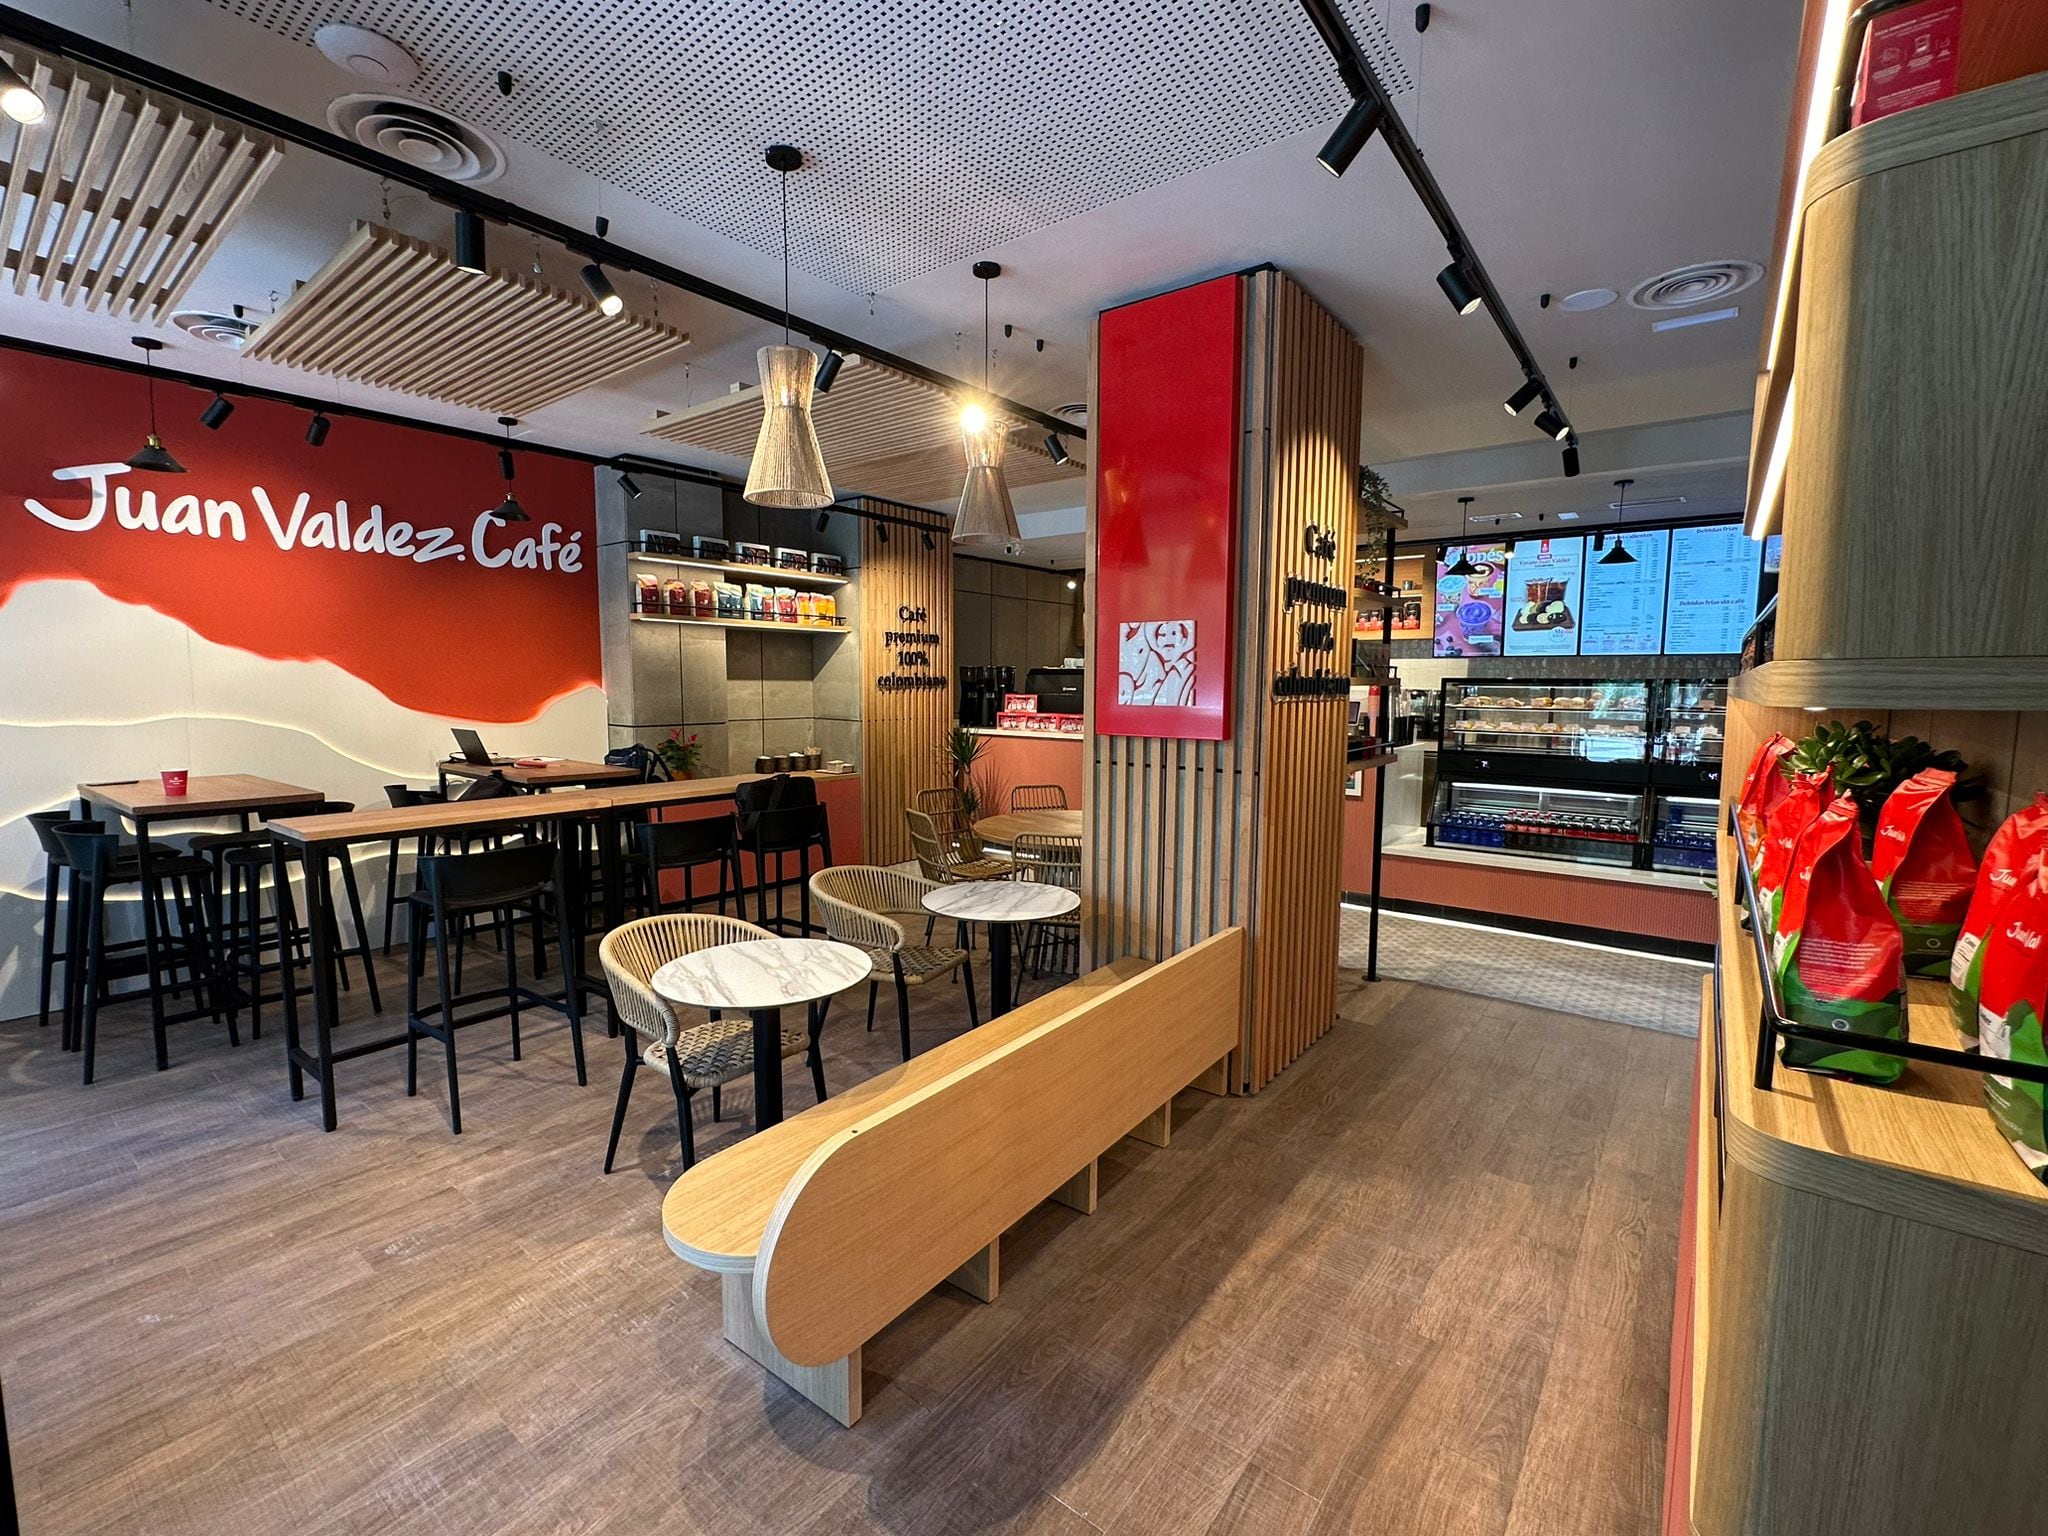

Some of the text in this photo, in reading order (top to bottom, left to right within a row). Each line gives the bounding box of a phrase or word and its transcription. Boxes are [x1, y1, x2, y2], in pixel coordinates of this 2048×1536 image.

[24, 462, 247, 542] Juan
[471, 509, 584, 574] Café
[898, 605, 928, 622] Café
[884, 629, 940, 647] premium
[897, 650, 930, 667] 100%
[876, 671, 947, 690] colombiano
